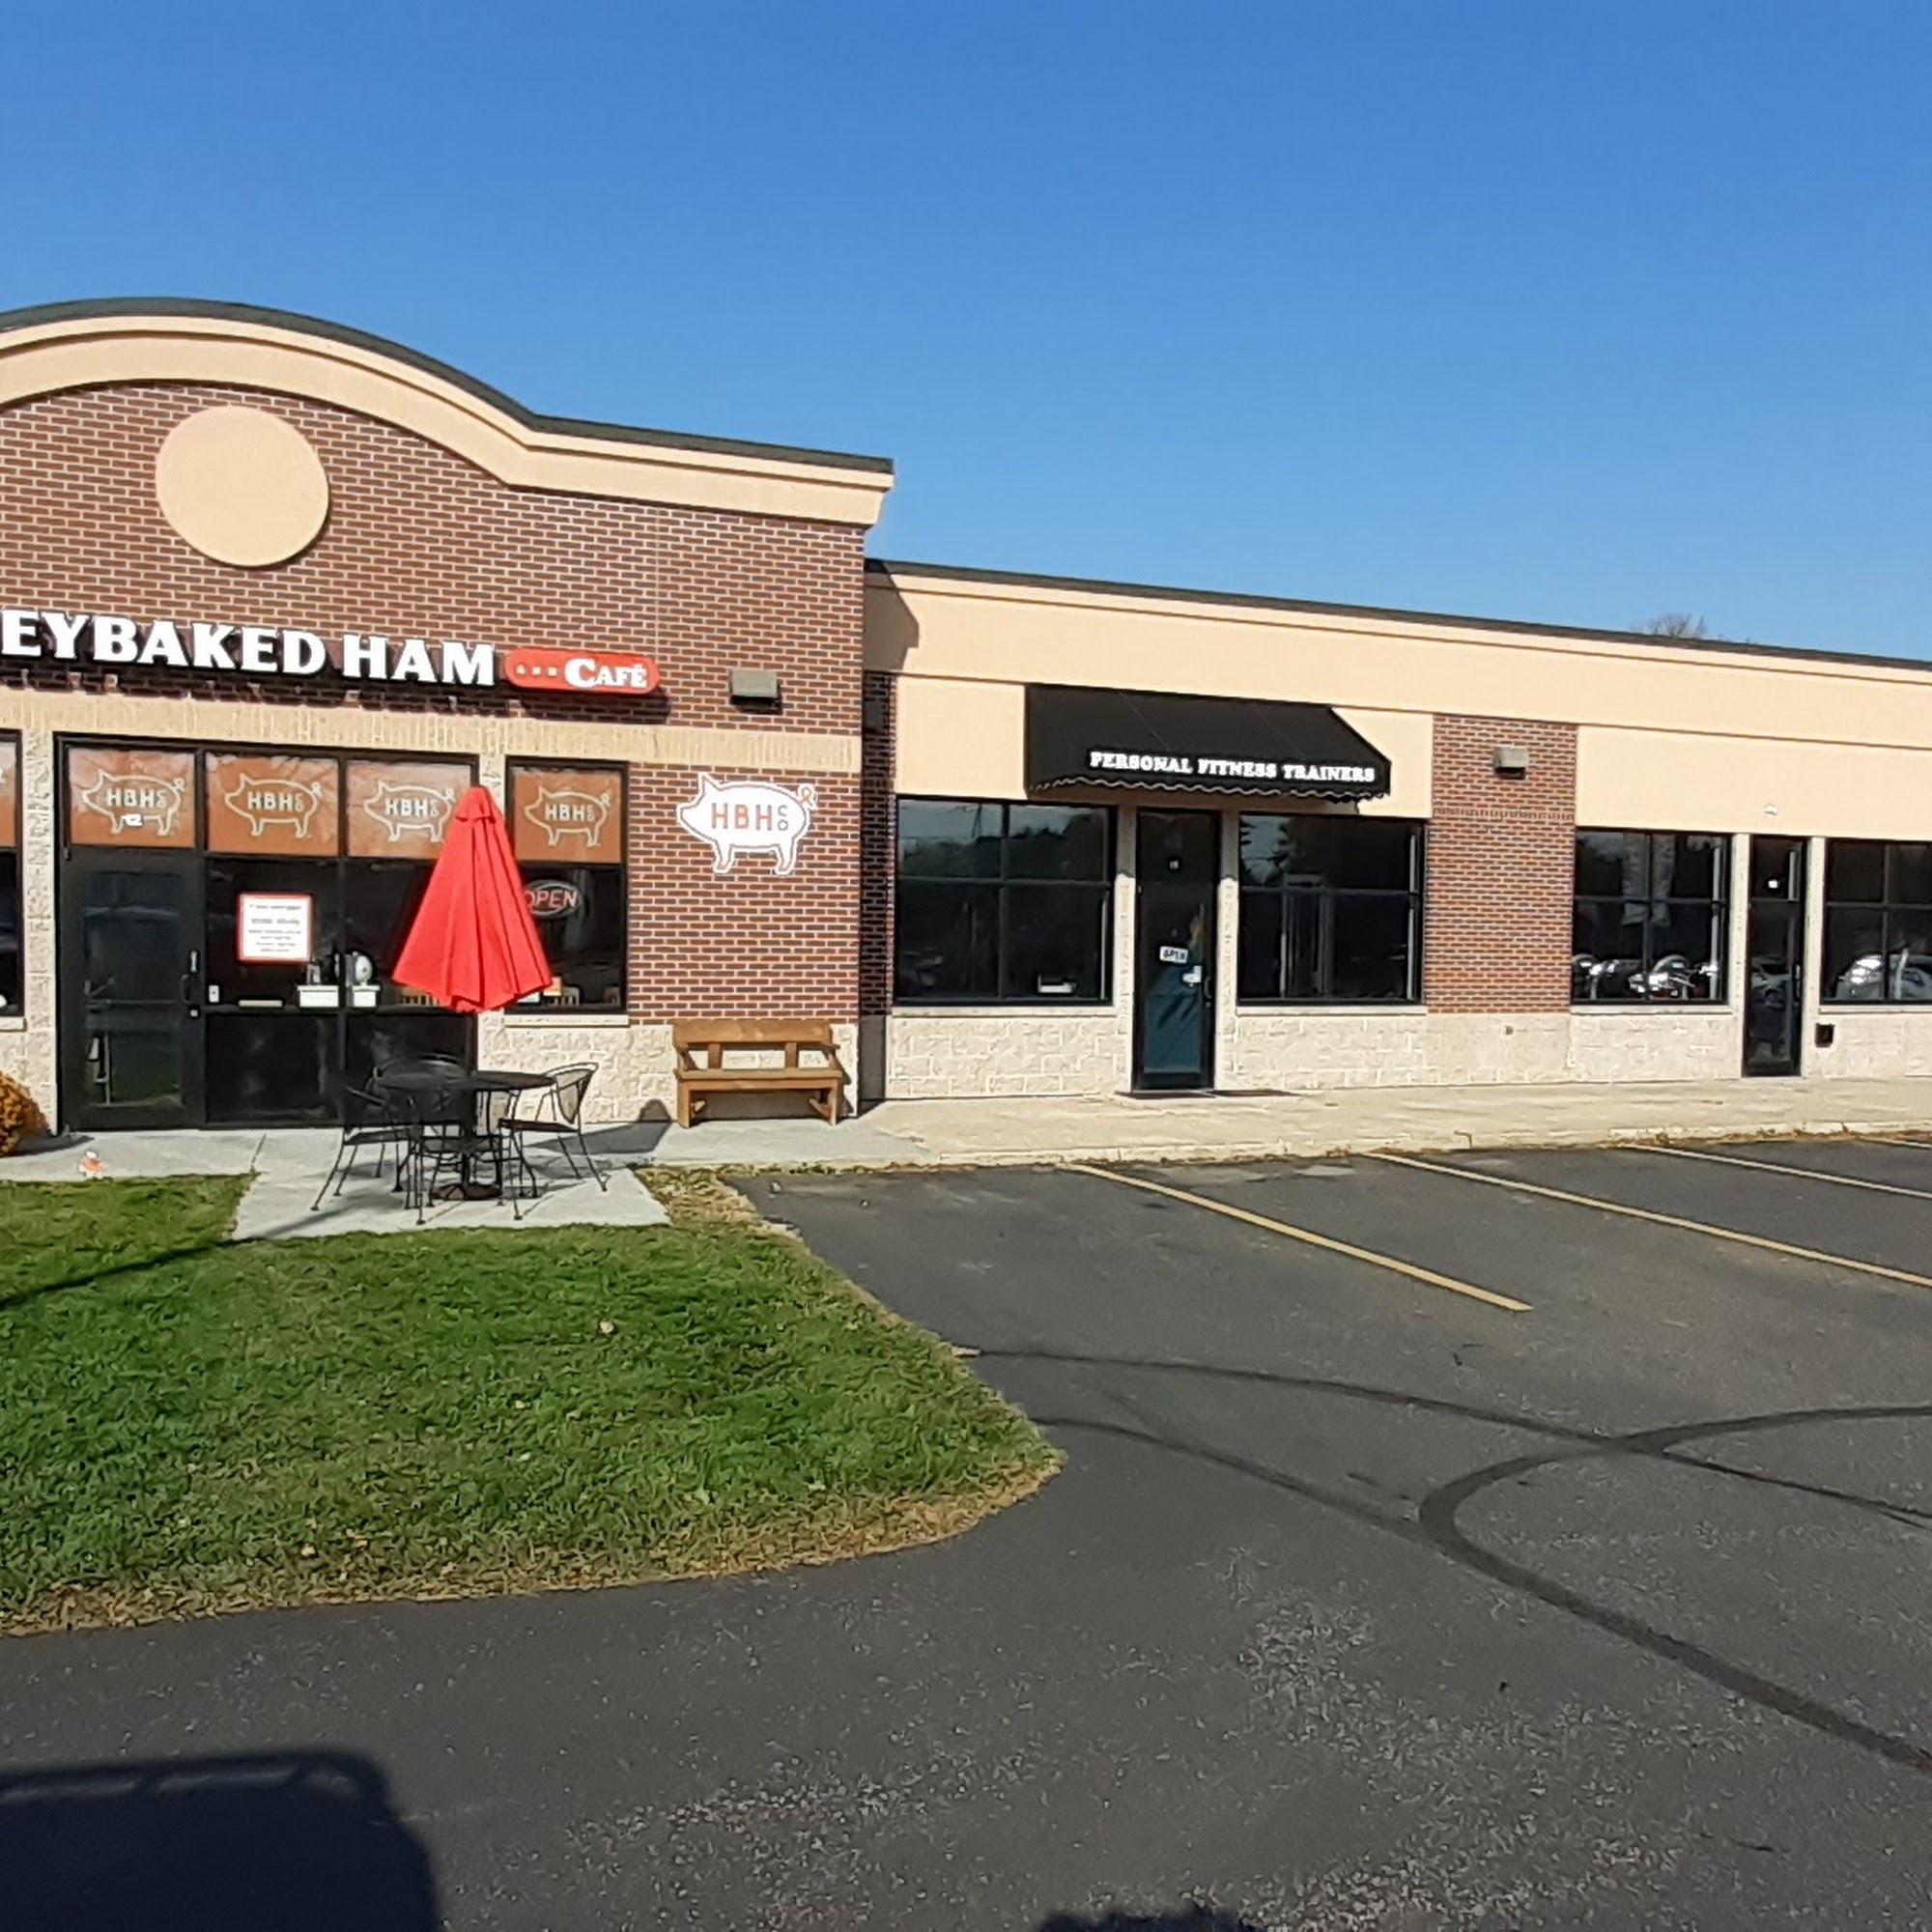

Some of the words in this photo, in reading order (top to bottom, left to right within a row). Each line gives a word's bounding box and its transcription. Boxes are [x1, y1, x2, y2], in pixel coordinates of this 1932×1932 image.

[1, 610, 327, 674] EYBAKED
[342, 634, 495, 686] HAM
[1090, 752, 1193, 774] PERSONAL
[1197, 759, 1277, 779] FITNESS
[1283, 764, 1376, 782] TRAINERS
[711, 802, 773, 831] HBH
[524, 890, 578, 908] OPEN
